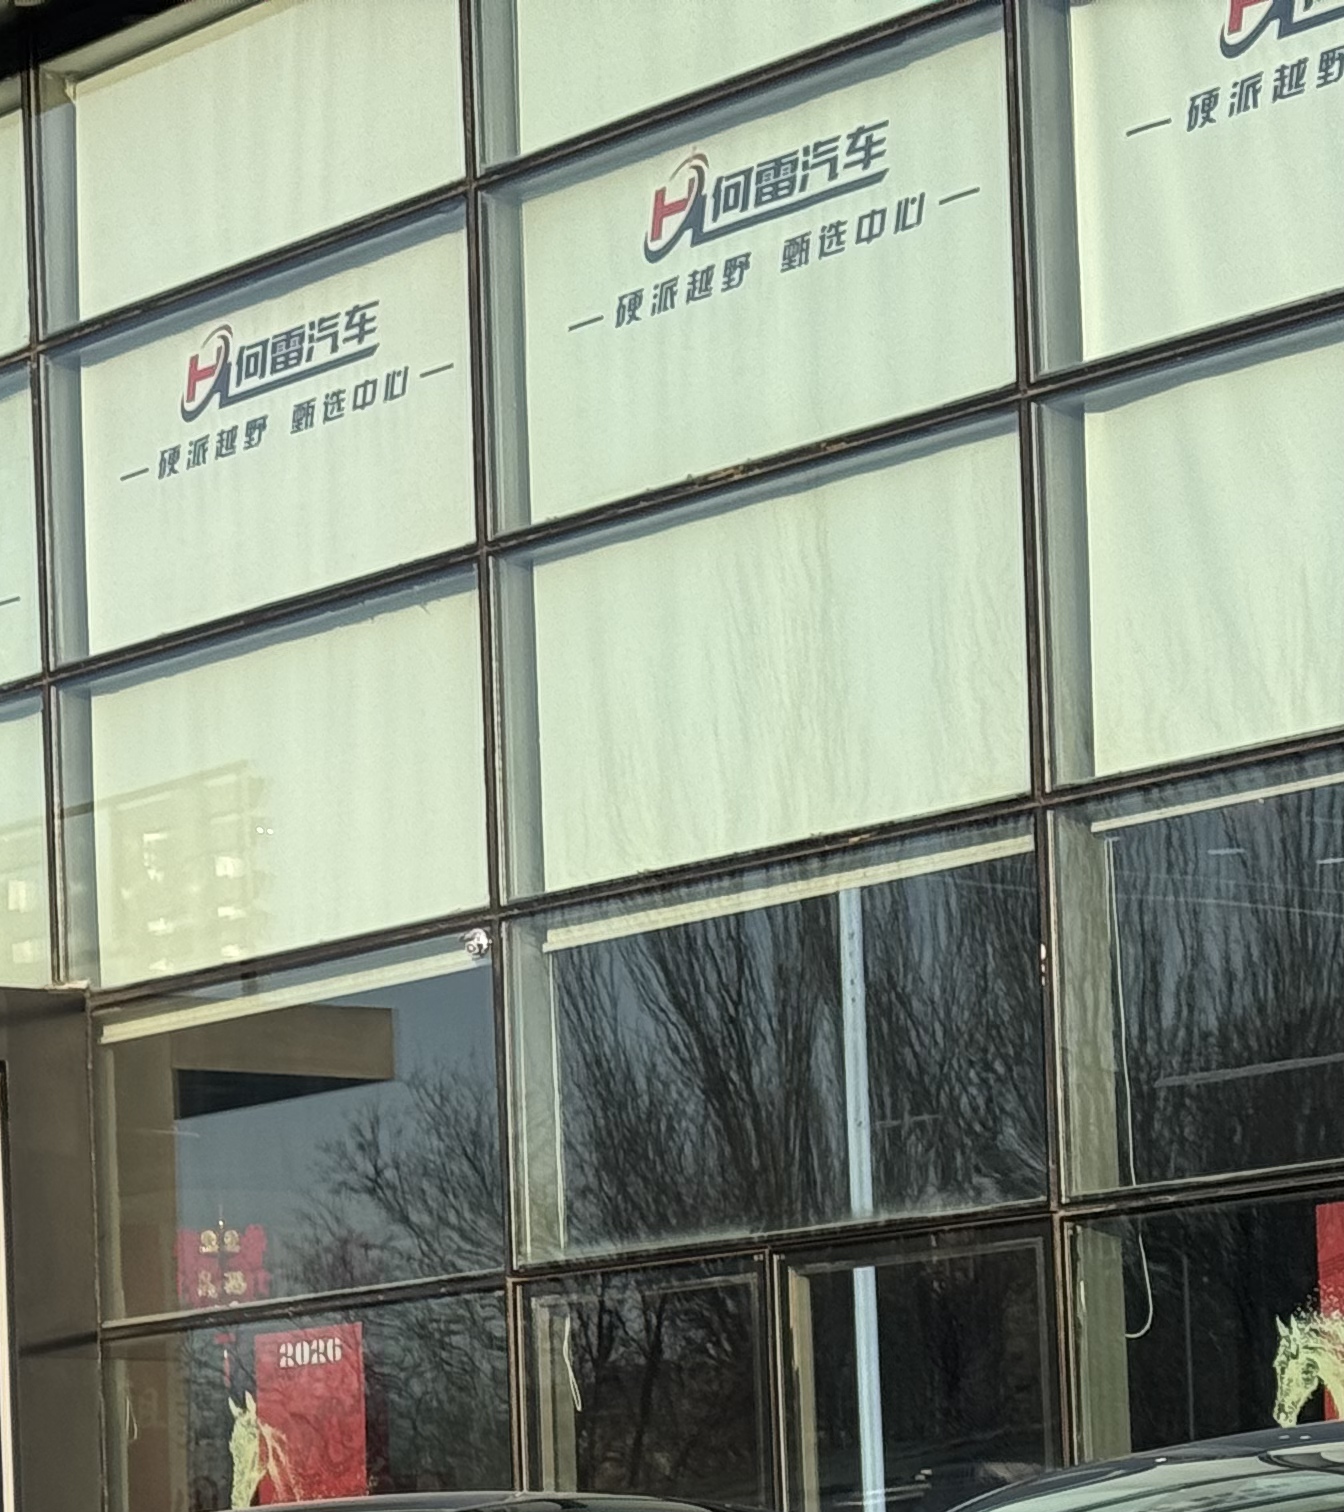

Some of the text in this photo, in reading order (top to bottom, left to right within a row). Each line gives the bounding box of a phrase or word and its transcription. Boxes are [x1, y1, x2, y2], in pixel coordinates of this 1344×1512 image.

[712, 119, 889, 223] 何雷汽车
[616, 191, 927, 328] 硬派越野 甄选中心
[235, 299, 379, 387] 何雷汽车
[158, 366, 409, 480] 硬派越野 甄选中心
[279, 1337, 342, 1369] 2026
